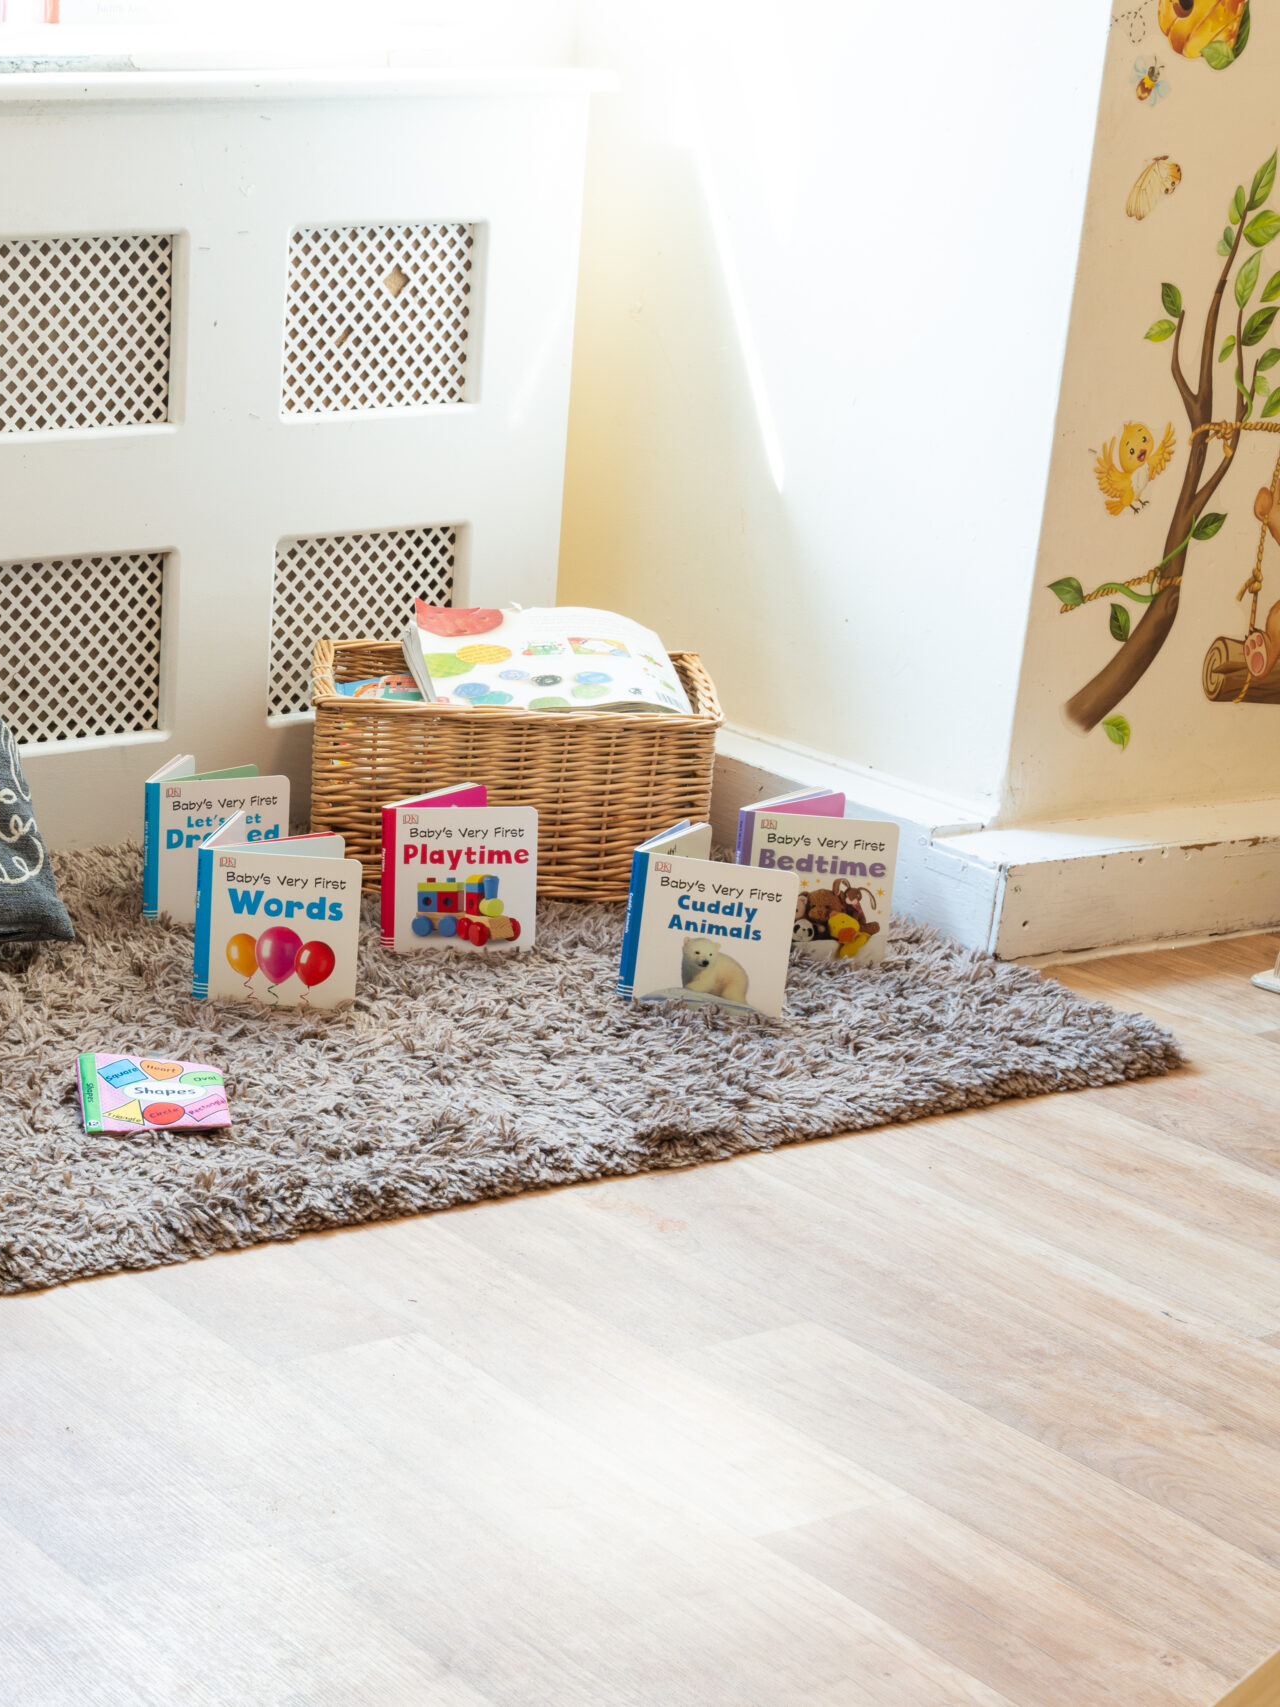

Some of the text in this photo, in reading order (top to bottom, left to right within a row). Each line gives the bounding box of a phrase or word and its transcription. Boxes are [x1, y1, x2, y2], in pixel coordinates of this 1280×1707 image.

[166, 787, 181, 798] DK
[172, 796, 278, 811] Baby's Very First
[187, 813, 262, 828] Let's et
[403, 814, 419, 824] DK
[760, 818, 777, 830] DK
[166, 824, 280, 849] Dred
[409, 826, 525, 840] Baby's Very First
[767, 833, 886, 852] Baby's Very First
[220, 857, 236, 868] DK
[403, 843, 529, 870] Playtime
[758, 848, 886, 878] Bedtime
[655, 861, 672, 873] DK
[226, 871, 346, 890] Baby's Very First
[660, 876, 782, 903] Baby's Very First
[228, 888, 343, 921] Words
[677, 895, 758, 923] Cuddly
[668, 914, 762, 941] Animals
[105, 1067, 139, 1081] Square
[147, 1064, 176, 1073] Heart
[86, 1083, 95, 1103] Shapes
[134, 1086, 196, 1097] Shapes
[149, 1107, 179, 1119] Circle
